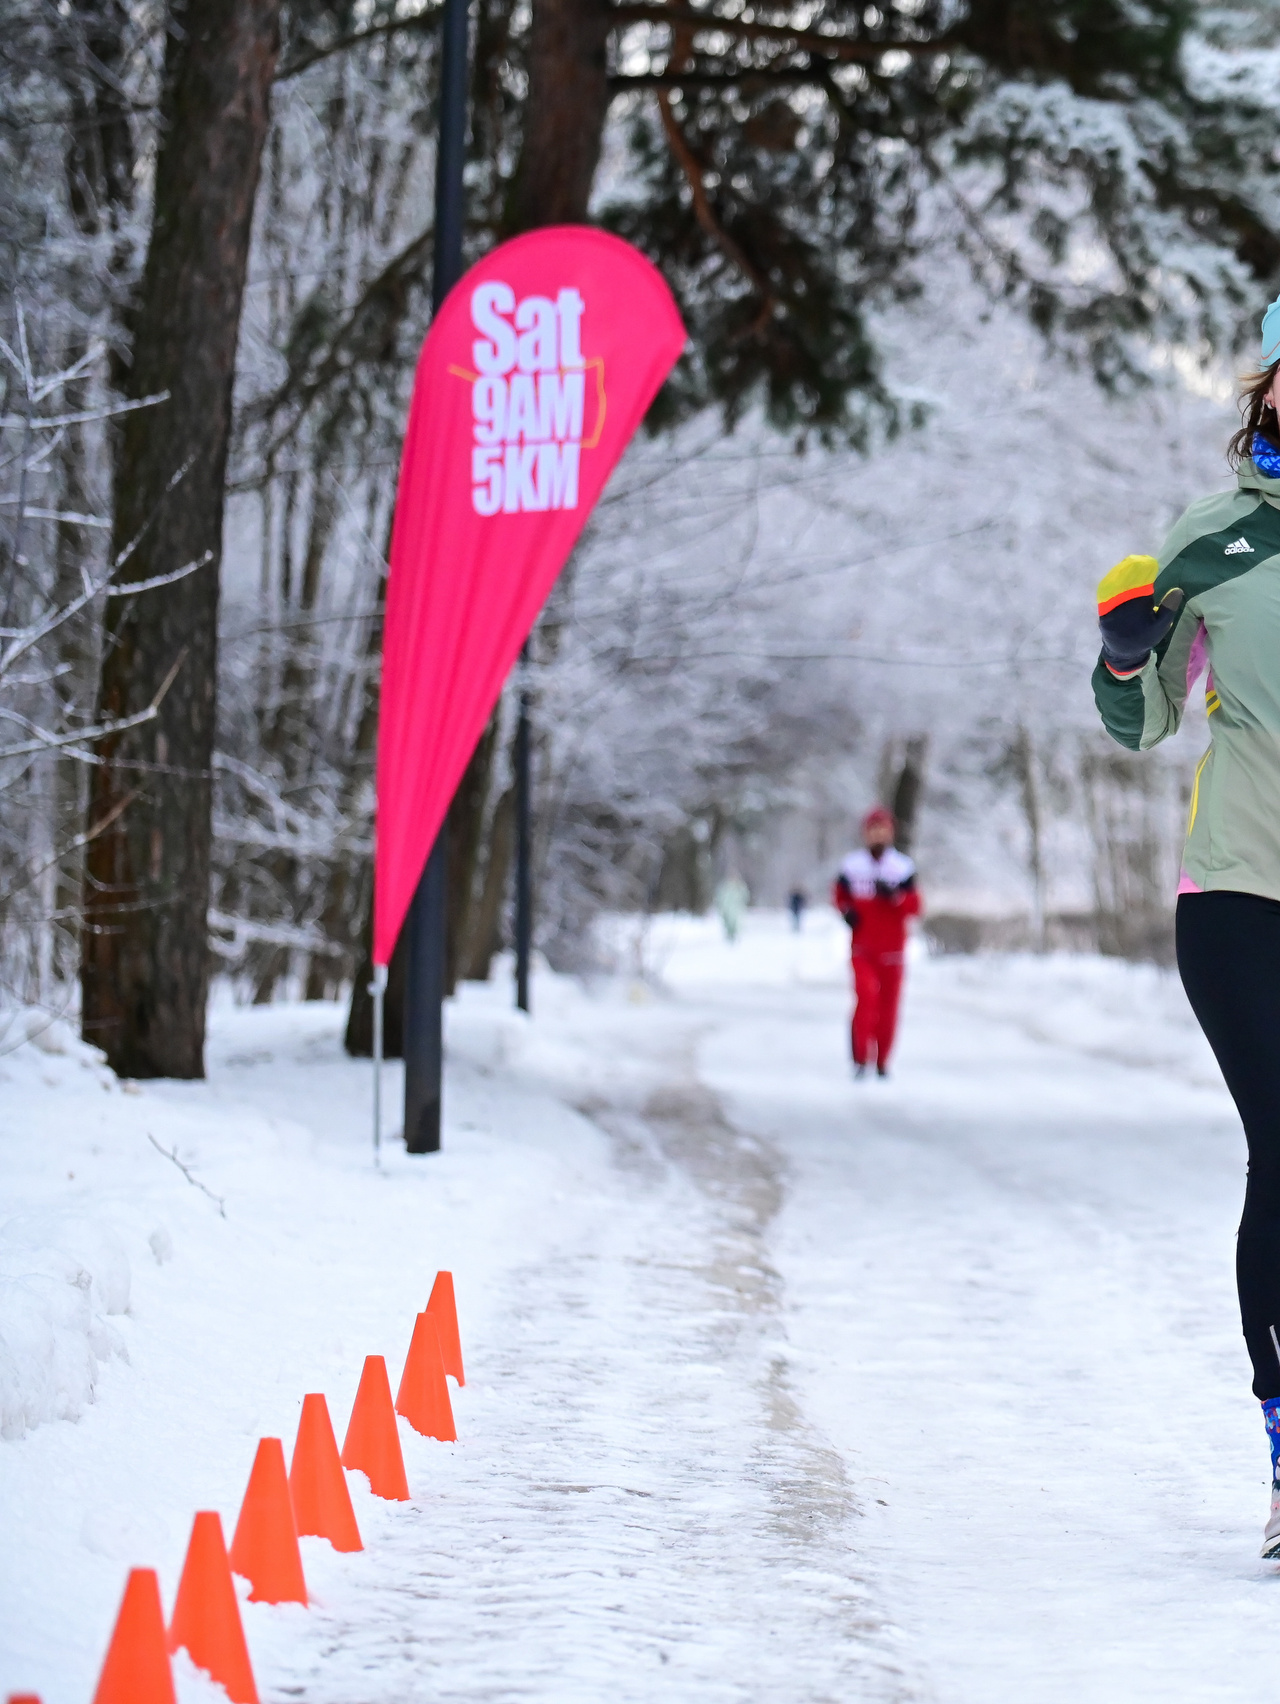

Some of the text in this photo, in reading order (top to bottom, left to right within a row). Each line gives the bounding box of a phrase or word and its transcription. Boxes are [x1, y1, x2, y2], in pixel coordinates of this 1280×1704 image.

[471, 280, 585, 375] Sat
[472, 373, 585, 444] 9AM
[472, 443, 581, 516] 5KM
[1224, 546, 1255, 556] adidas
